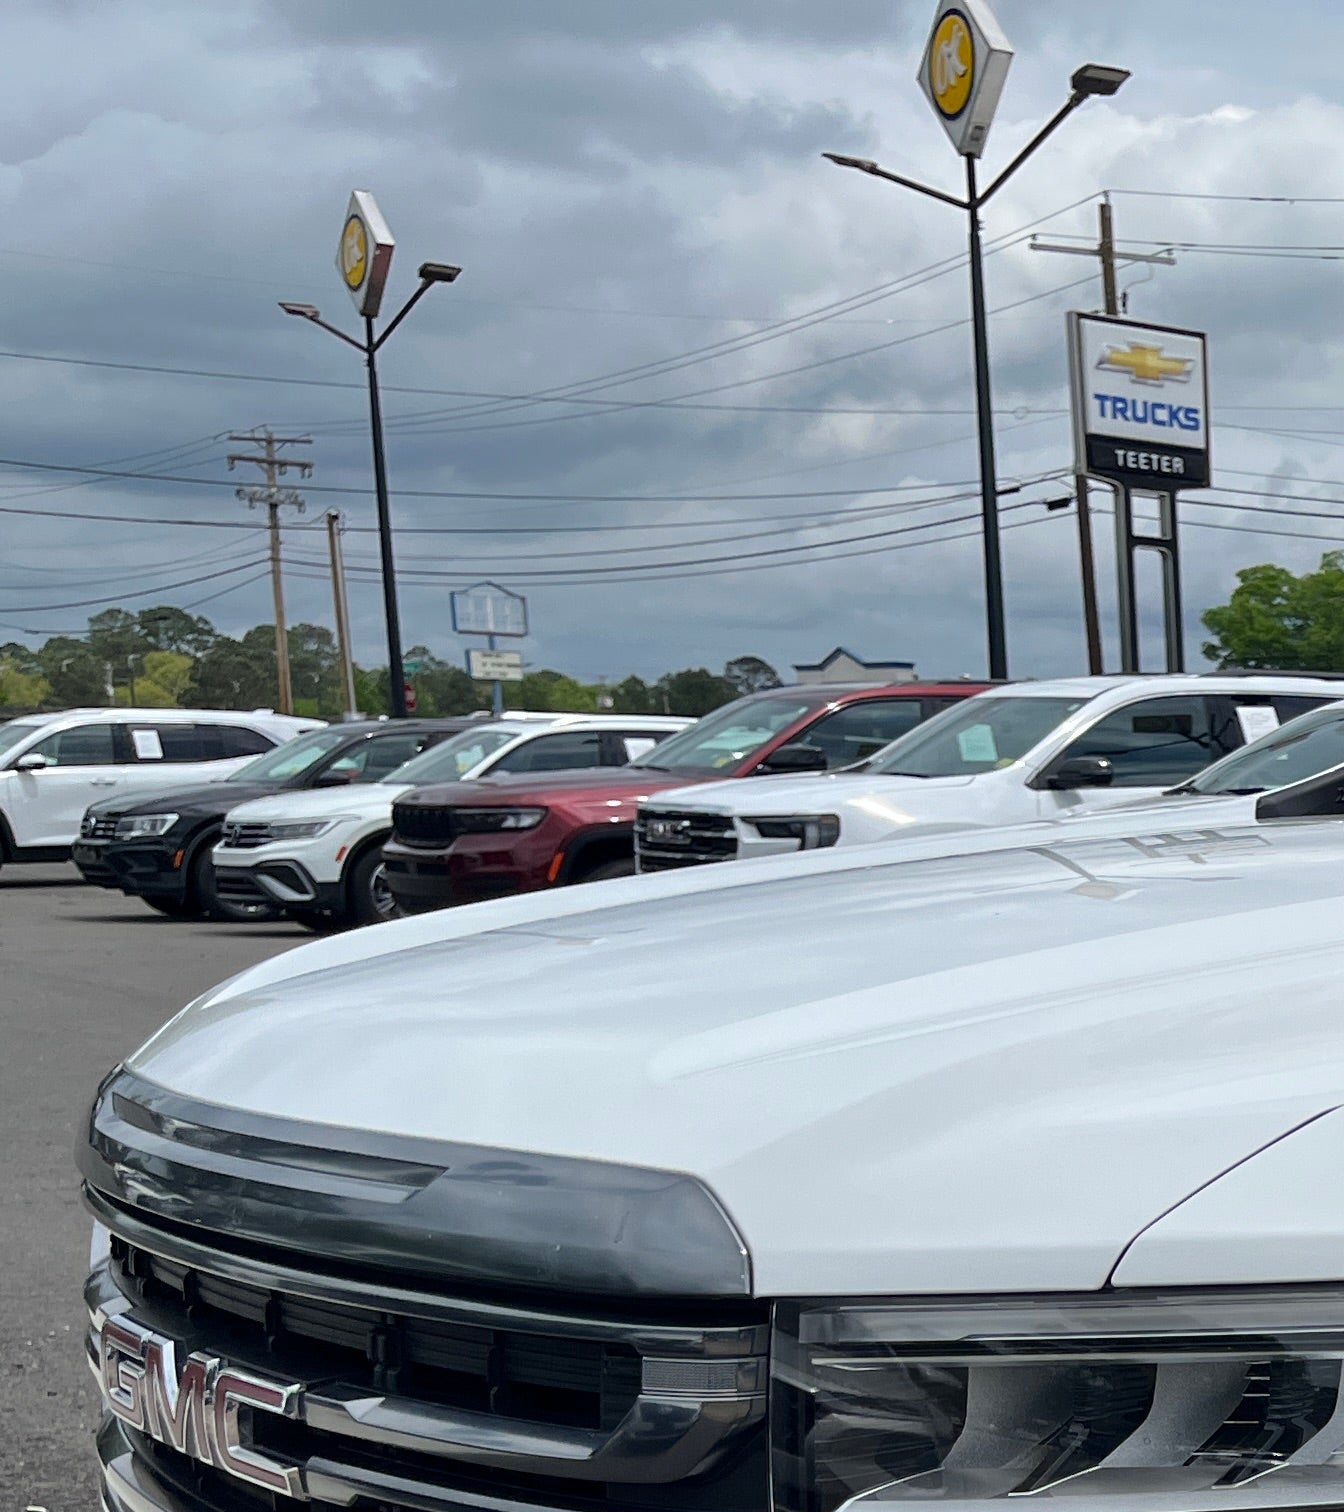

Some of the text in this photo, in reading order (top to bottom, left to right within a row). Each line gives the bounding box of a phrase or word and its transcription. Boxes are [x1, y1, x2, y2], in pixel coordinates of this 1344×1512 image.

[1093, 393, 1201, 432] TRUCKS
[1114, 447, 1185, 475] TEETER
[101, 1312, 308, 1500] GMC
